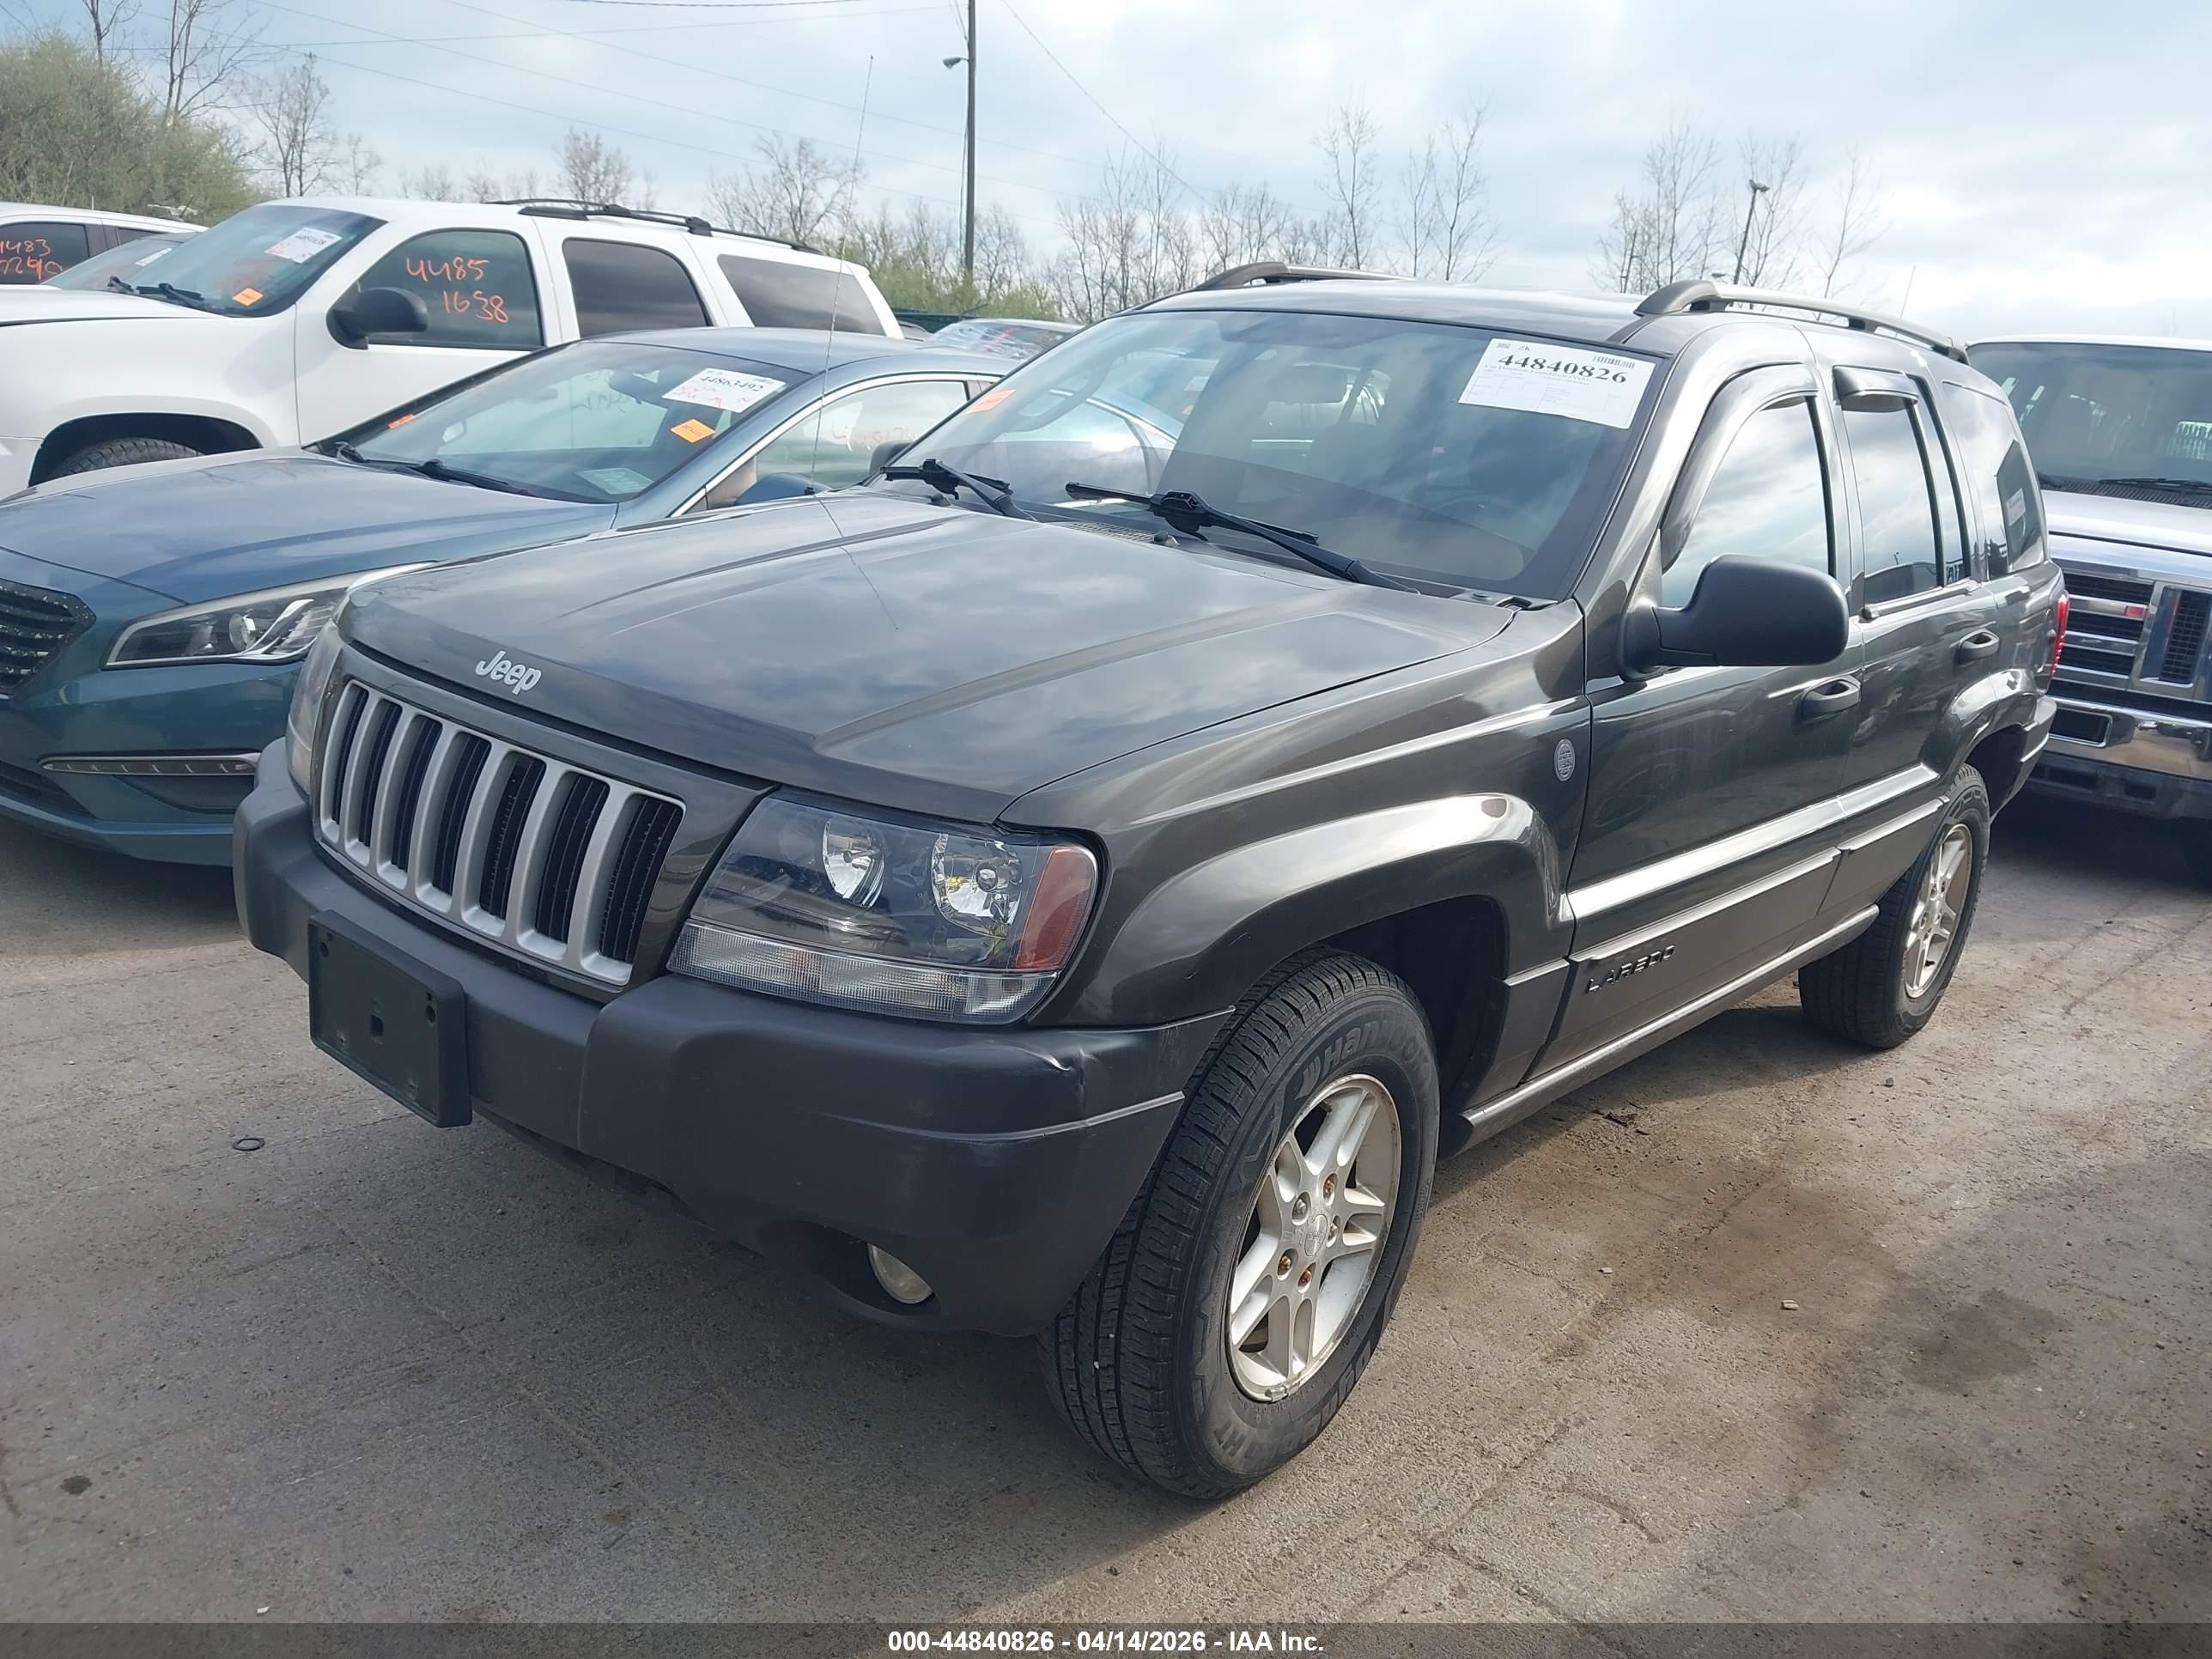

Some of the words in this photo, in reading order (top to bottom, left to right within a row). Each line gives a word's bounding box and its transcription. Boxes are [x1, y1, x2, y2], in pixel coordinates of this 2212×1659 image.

[405, 256, 490, 283] 4485
[442, 290, 508, 323] 1638
[1498, 354, 1628, 384] 44840826
[475, 650, 542, 695] Jeep
[1585, 944, 1675, 994] LAREDO
